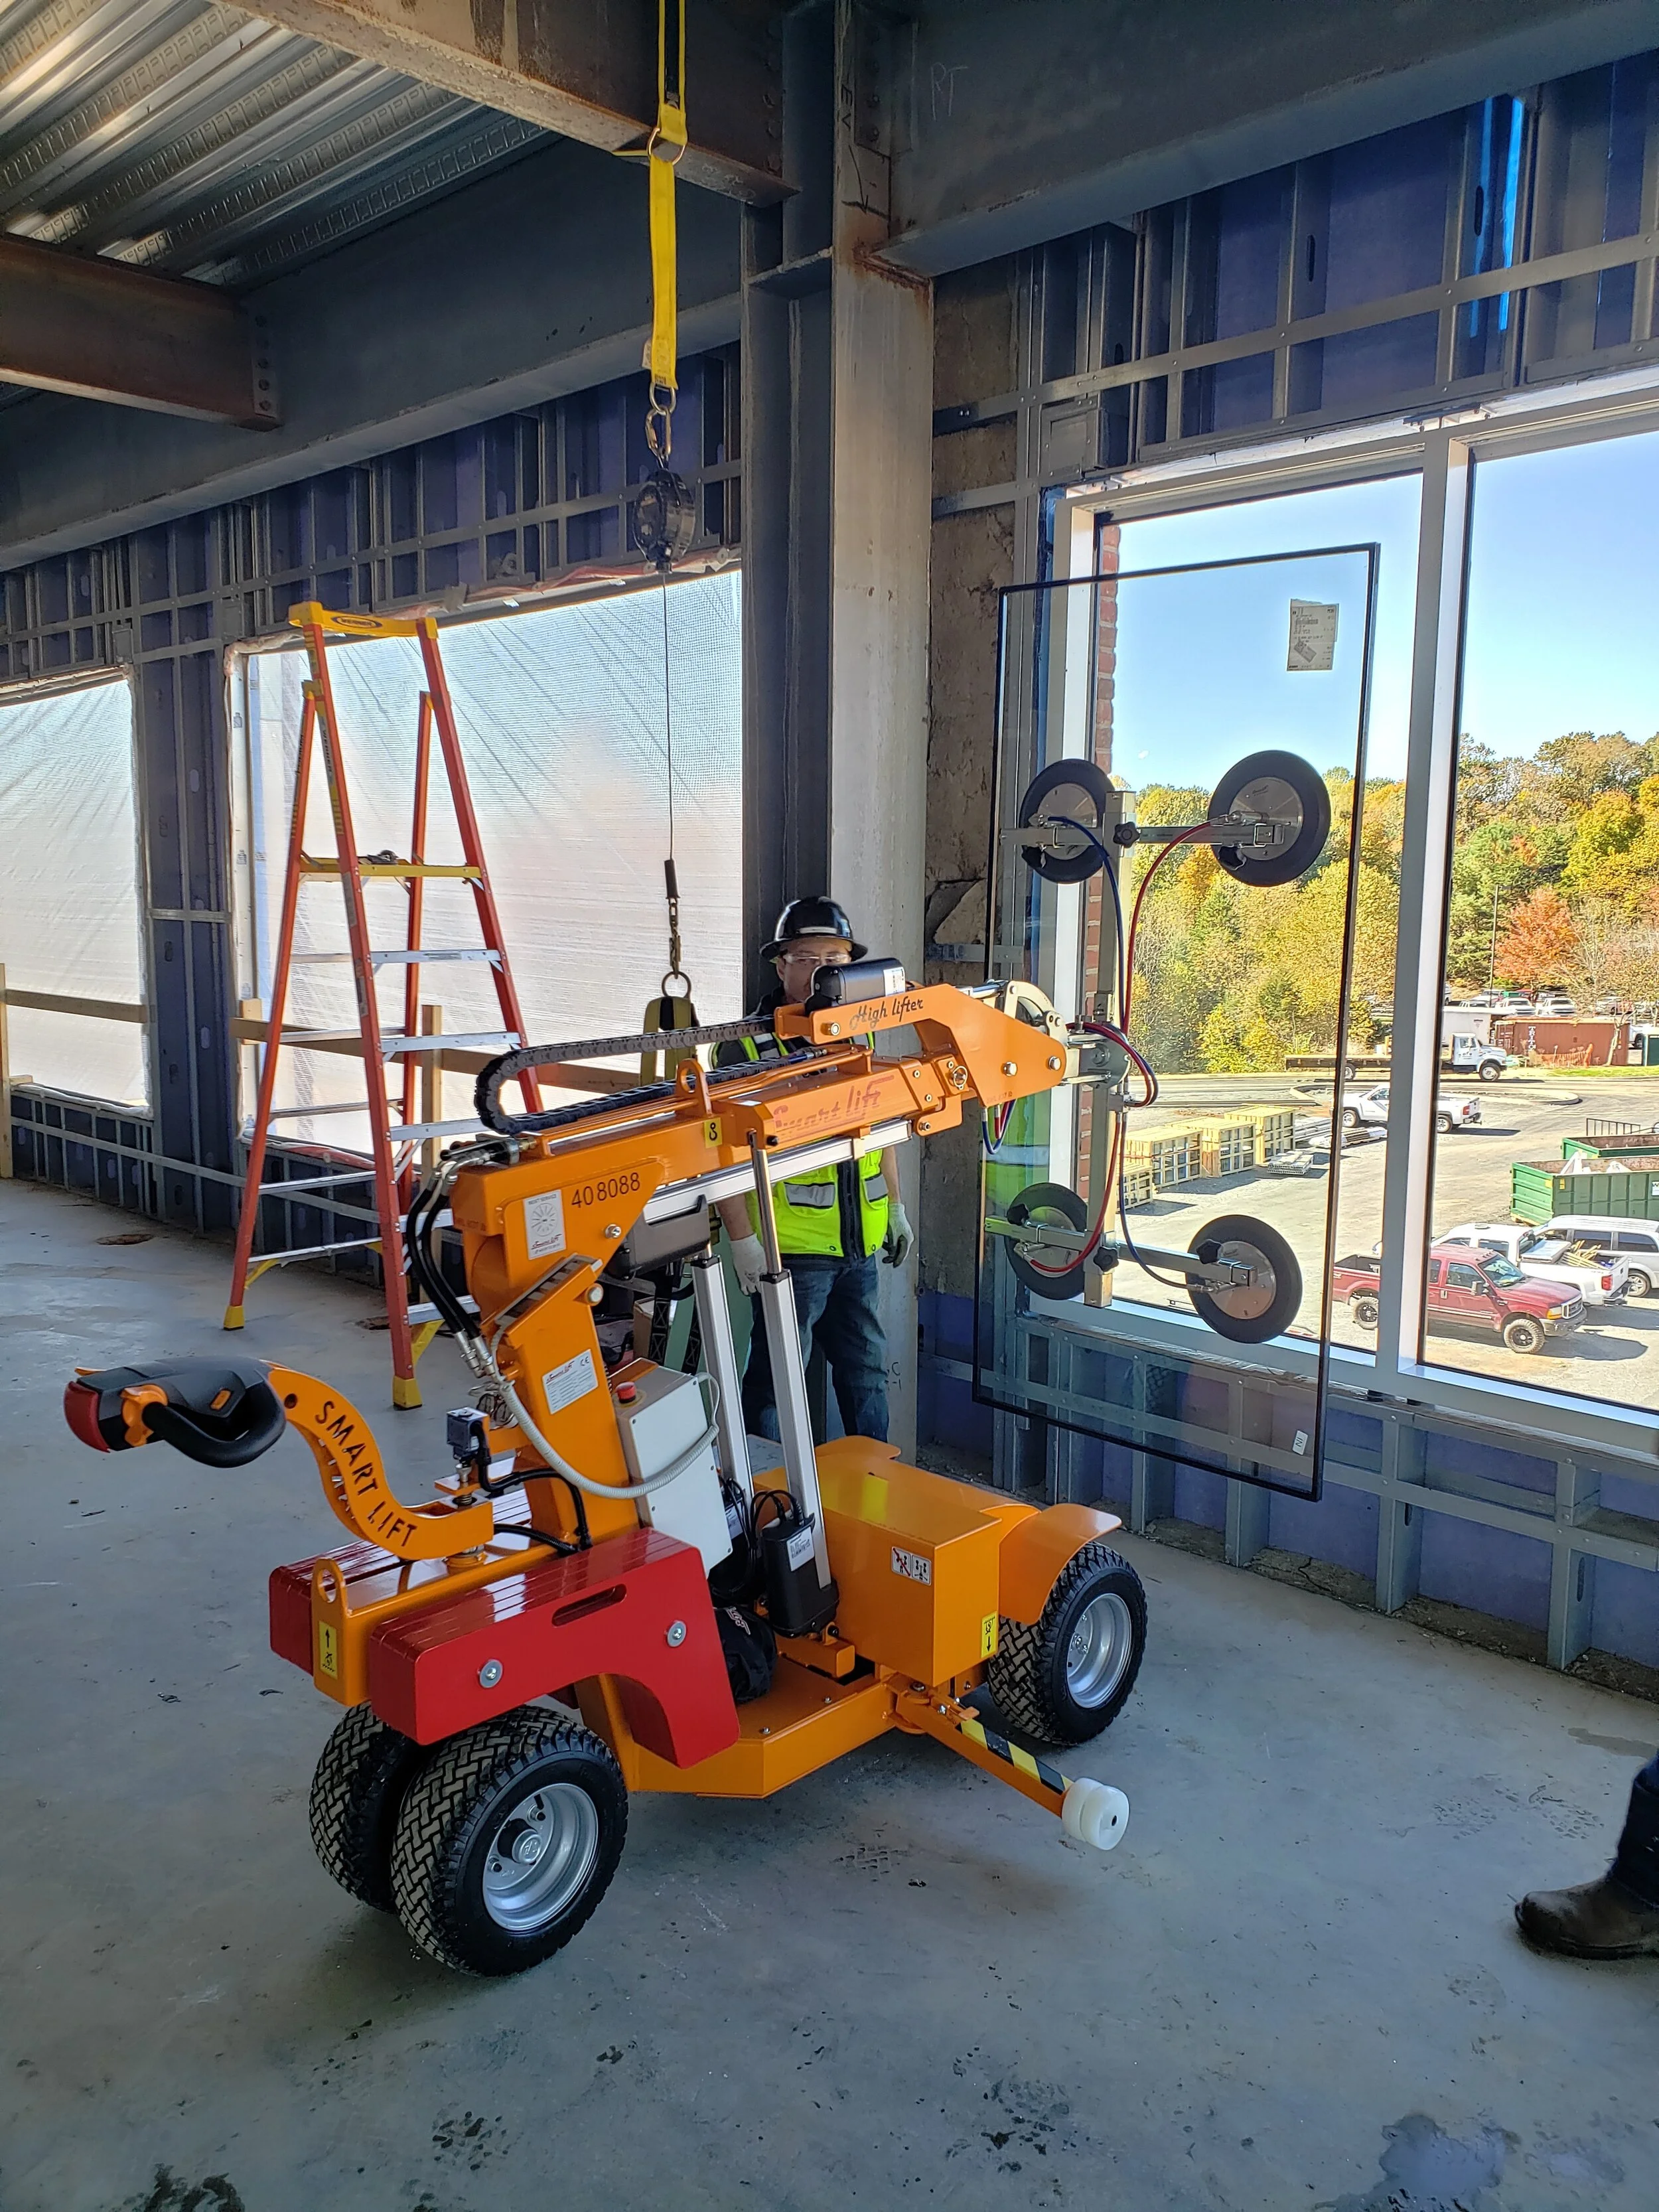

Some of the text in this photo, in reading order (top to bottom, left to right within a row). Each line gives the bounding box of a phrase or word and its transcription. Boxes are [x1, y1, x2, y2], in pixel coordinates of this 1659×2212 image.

[849, 995, 924, 1031] High lifter
[845, 1074, 895, 1110] lift
[315, 1400, 378, 1496] SMART
[367, 1501, 418, 1548] LIFT
